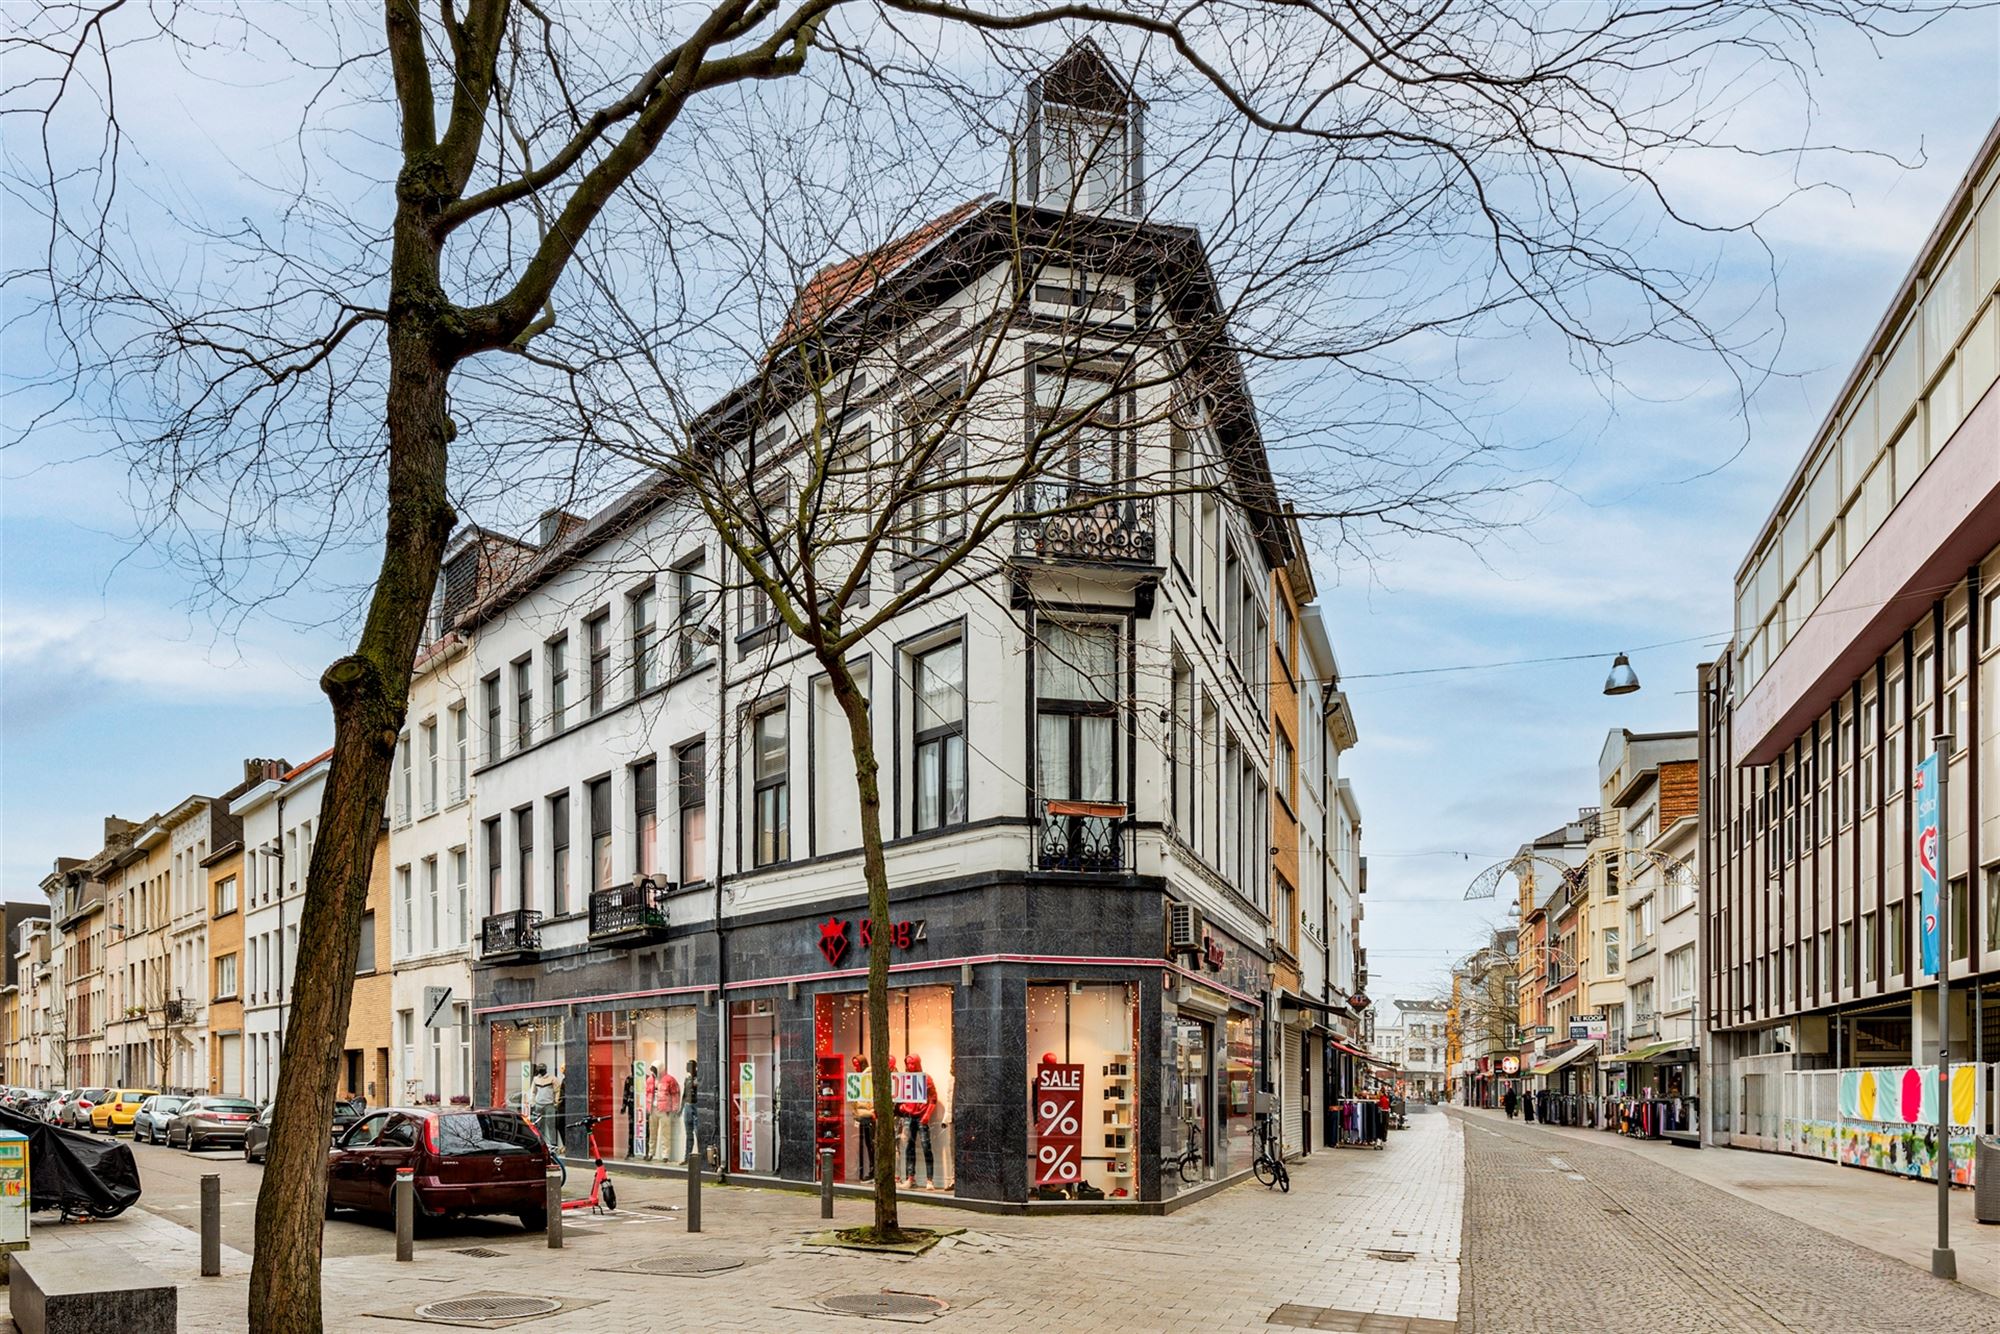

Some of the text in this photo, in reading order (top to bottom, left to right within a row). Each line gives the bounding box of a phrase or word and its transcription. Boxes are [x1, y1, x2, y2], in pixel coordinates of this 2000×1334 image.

[848, 1074, 926, 1100] SODEN
[1040, 1070, 1080, 1087] SALE
[742, 1064, 753, 1169] SOLDEN
[1041, 1100, 1078, 1136] %
[1039, 1145, 1077, 1181] %
